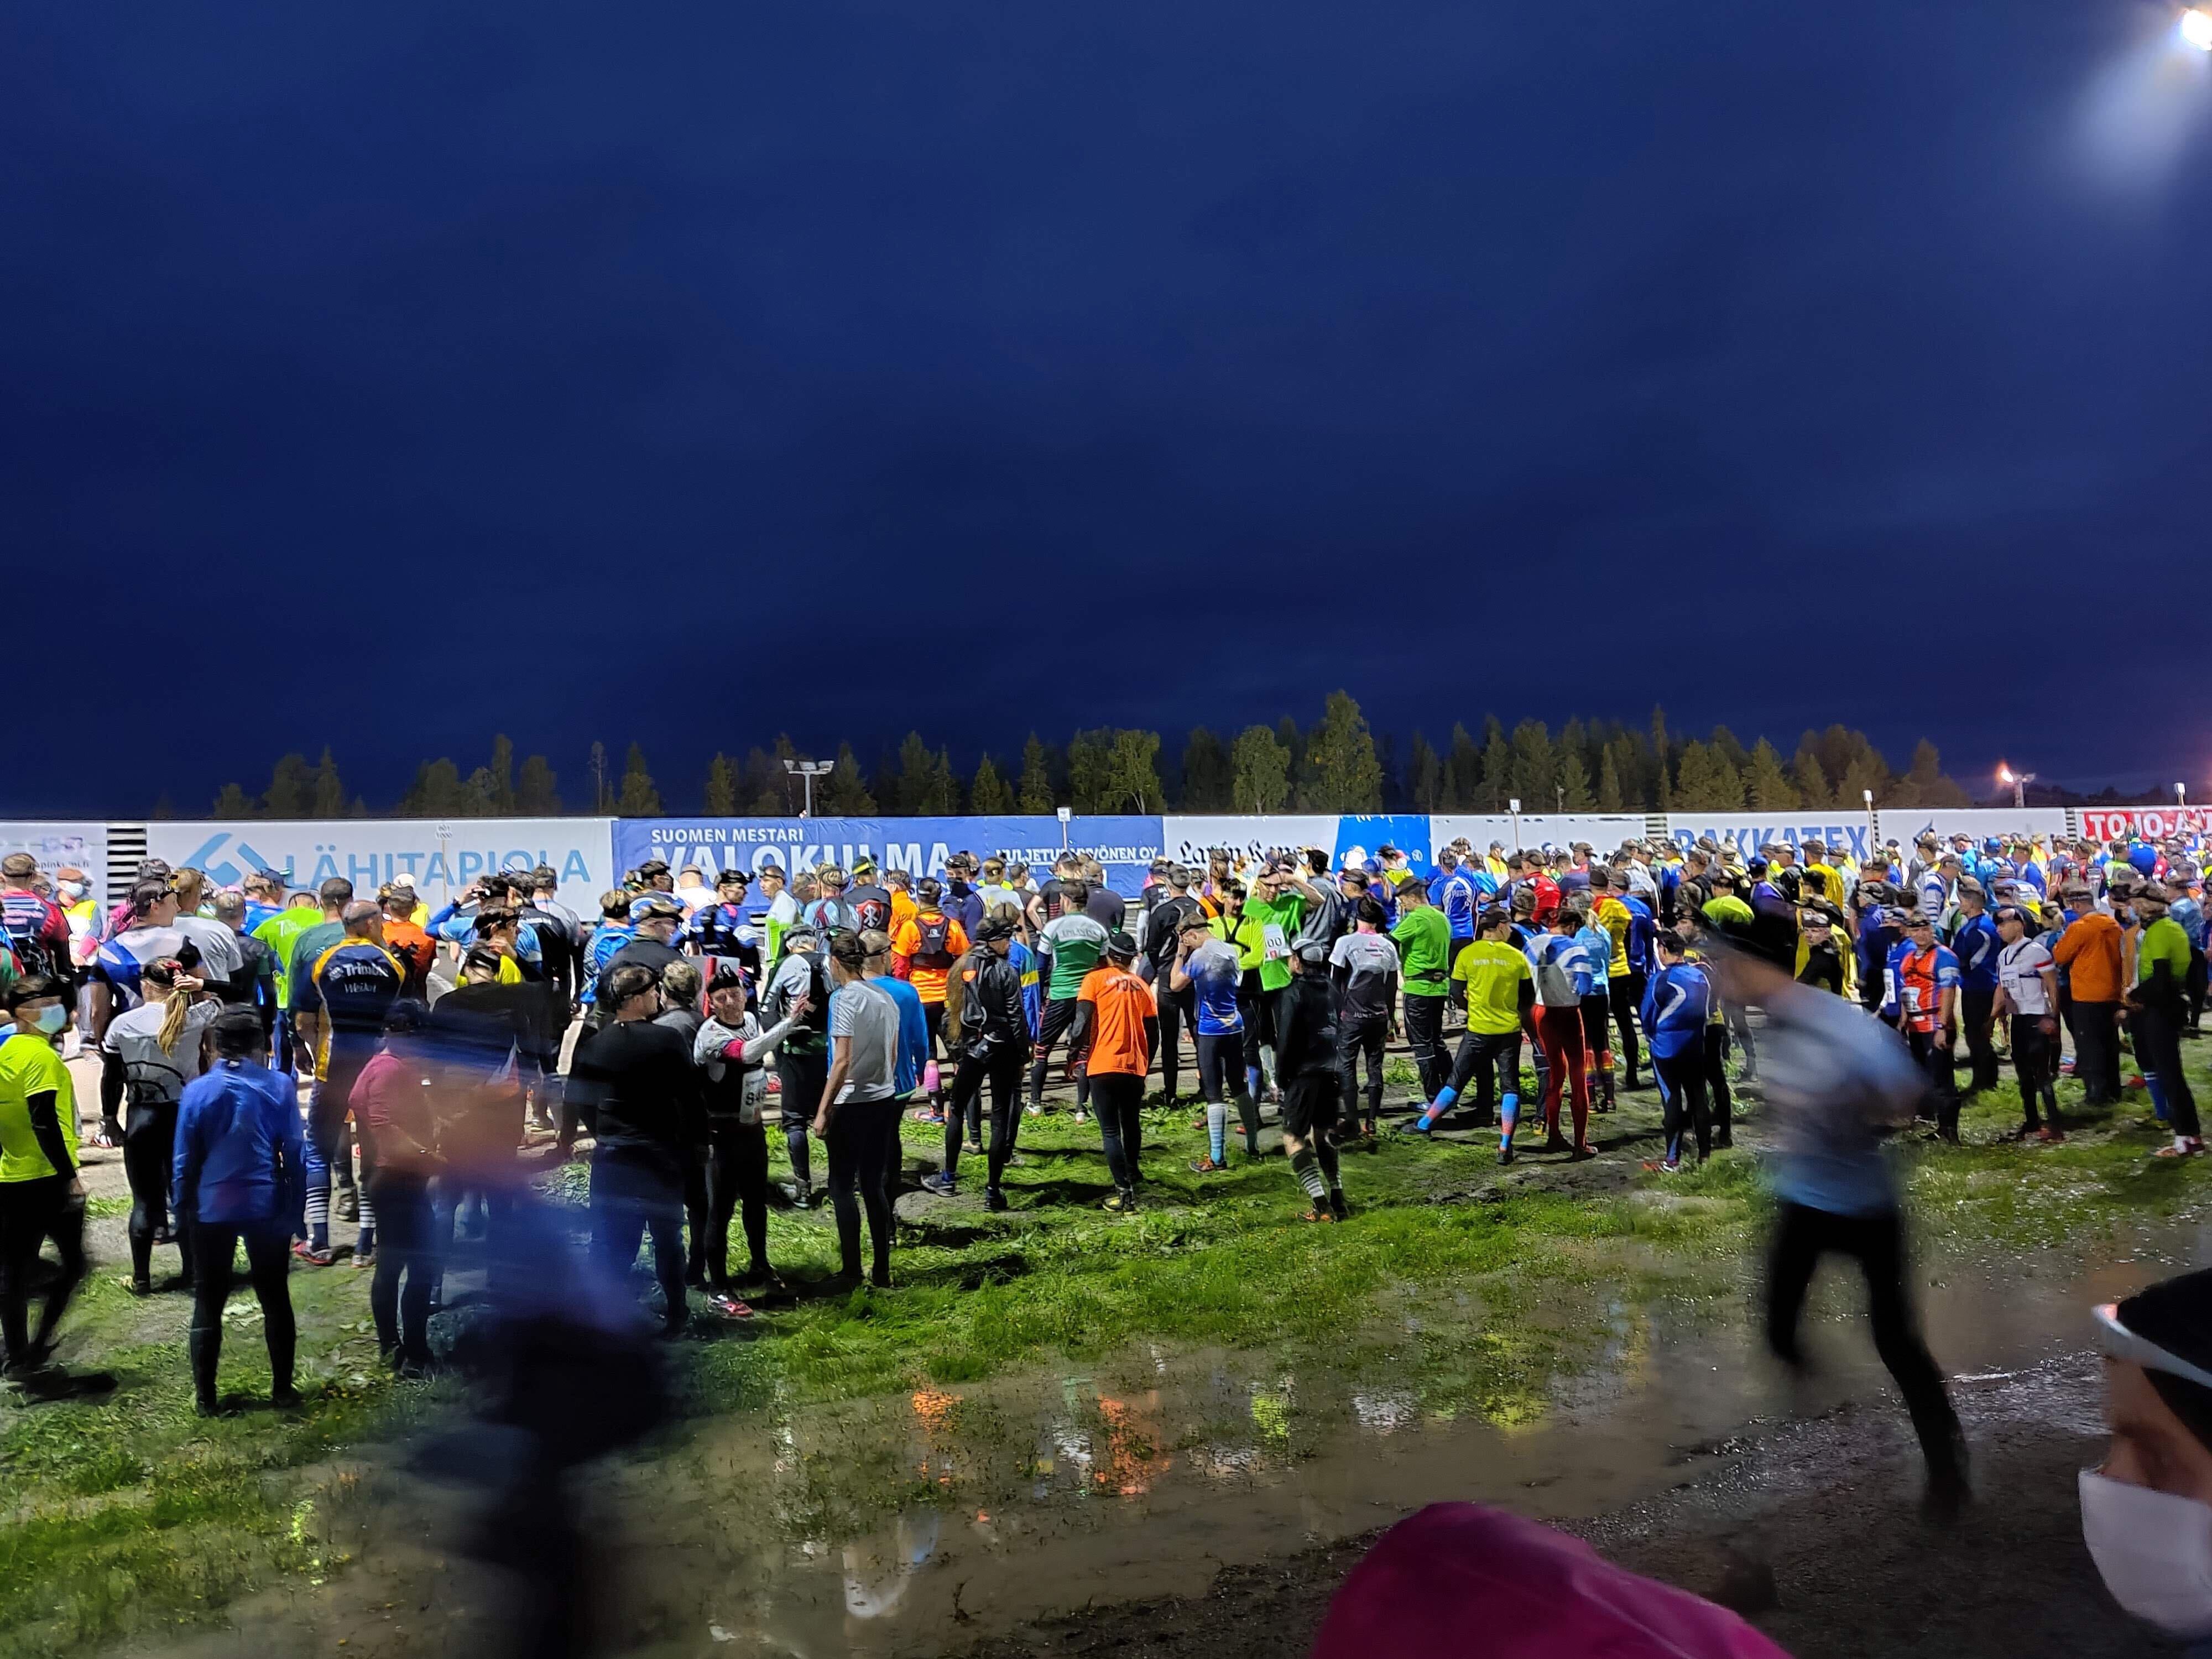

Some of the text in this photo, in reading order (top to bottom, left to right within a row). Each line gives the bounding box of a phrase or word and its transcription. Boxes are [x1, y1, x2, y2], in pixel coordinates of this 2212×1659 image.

[651, 828, 804, 843] SUOMEN MESTARI
[1139, 846, 1158, 860] OY
